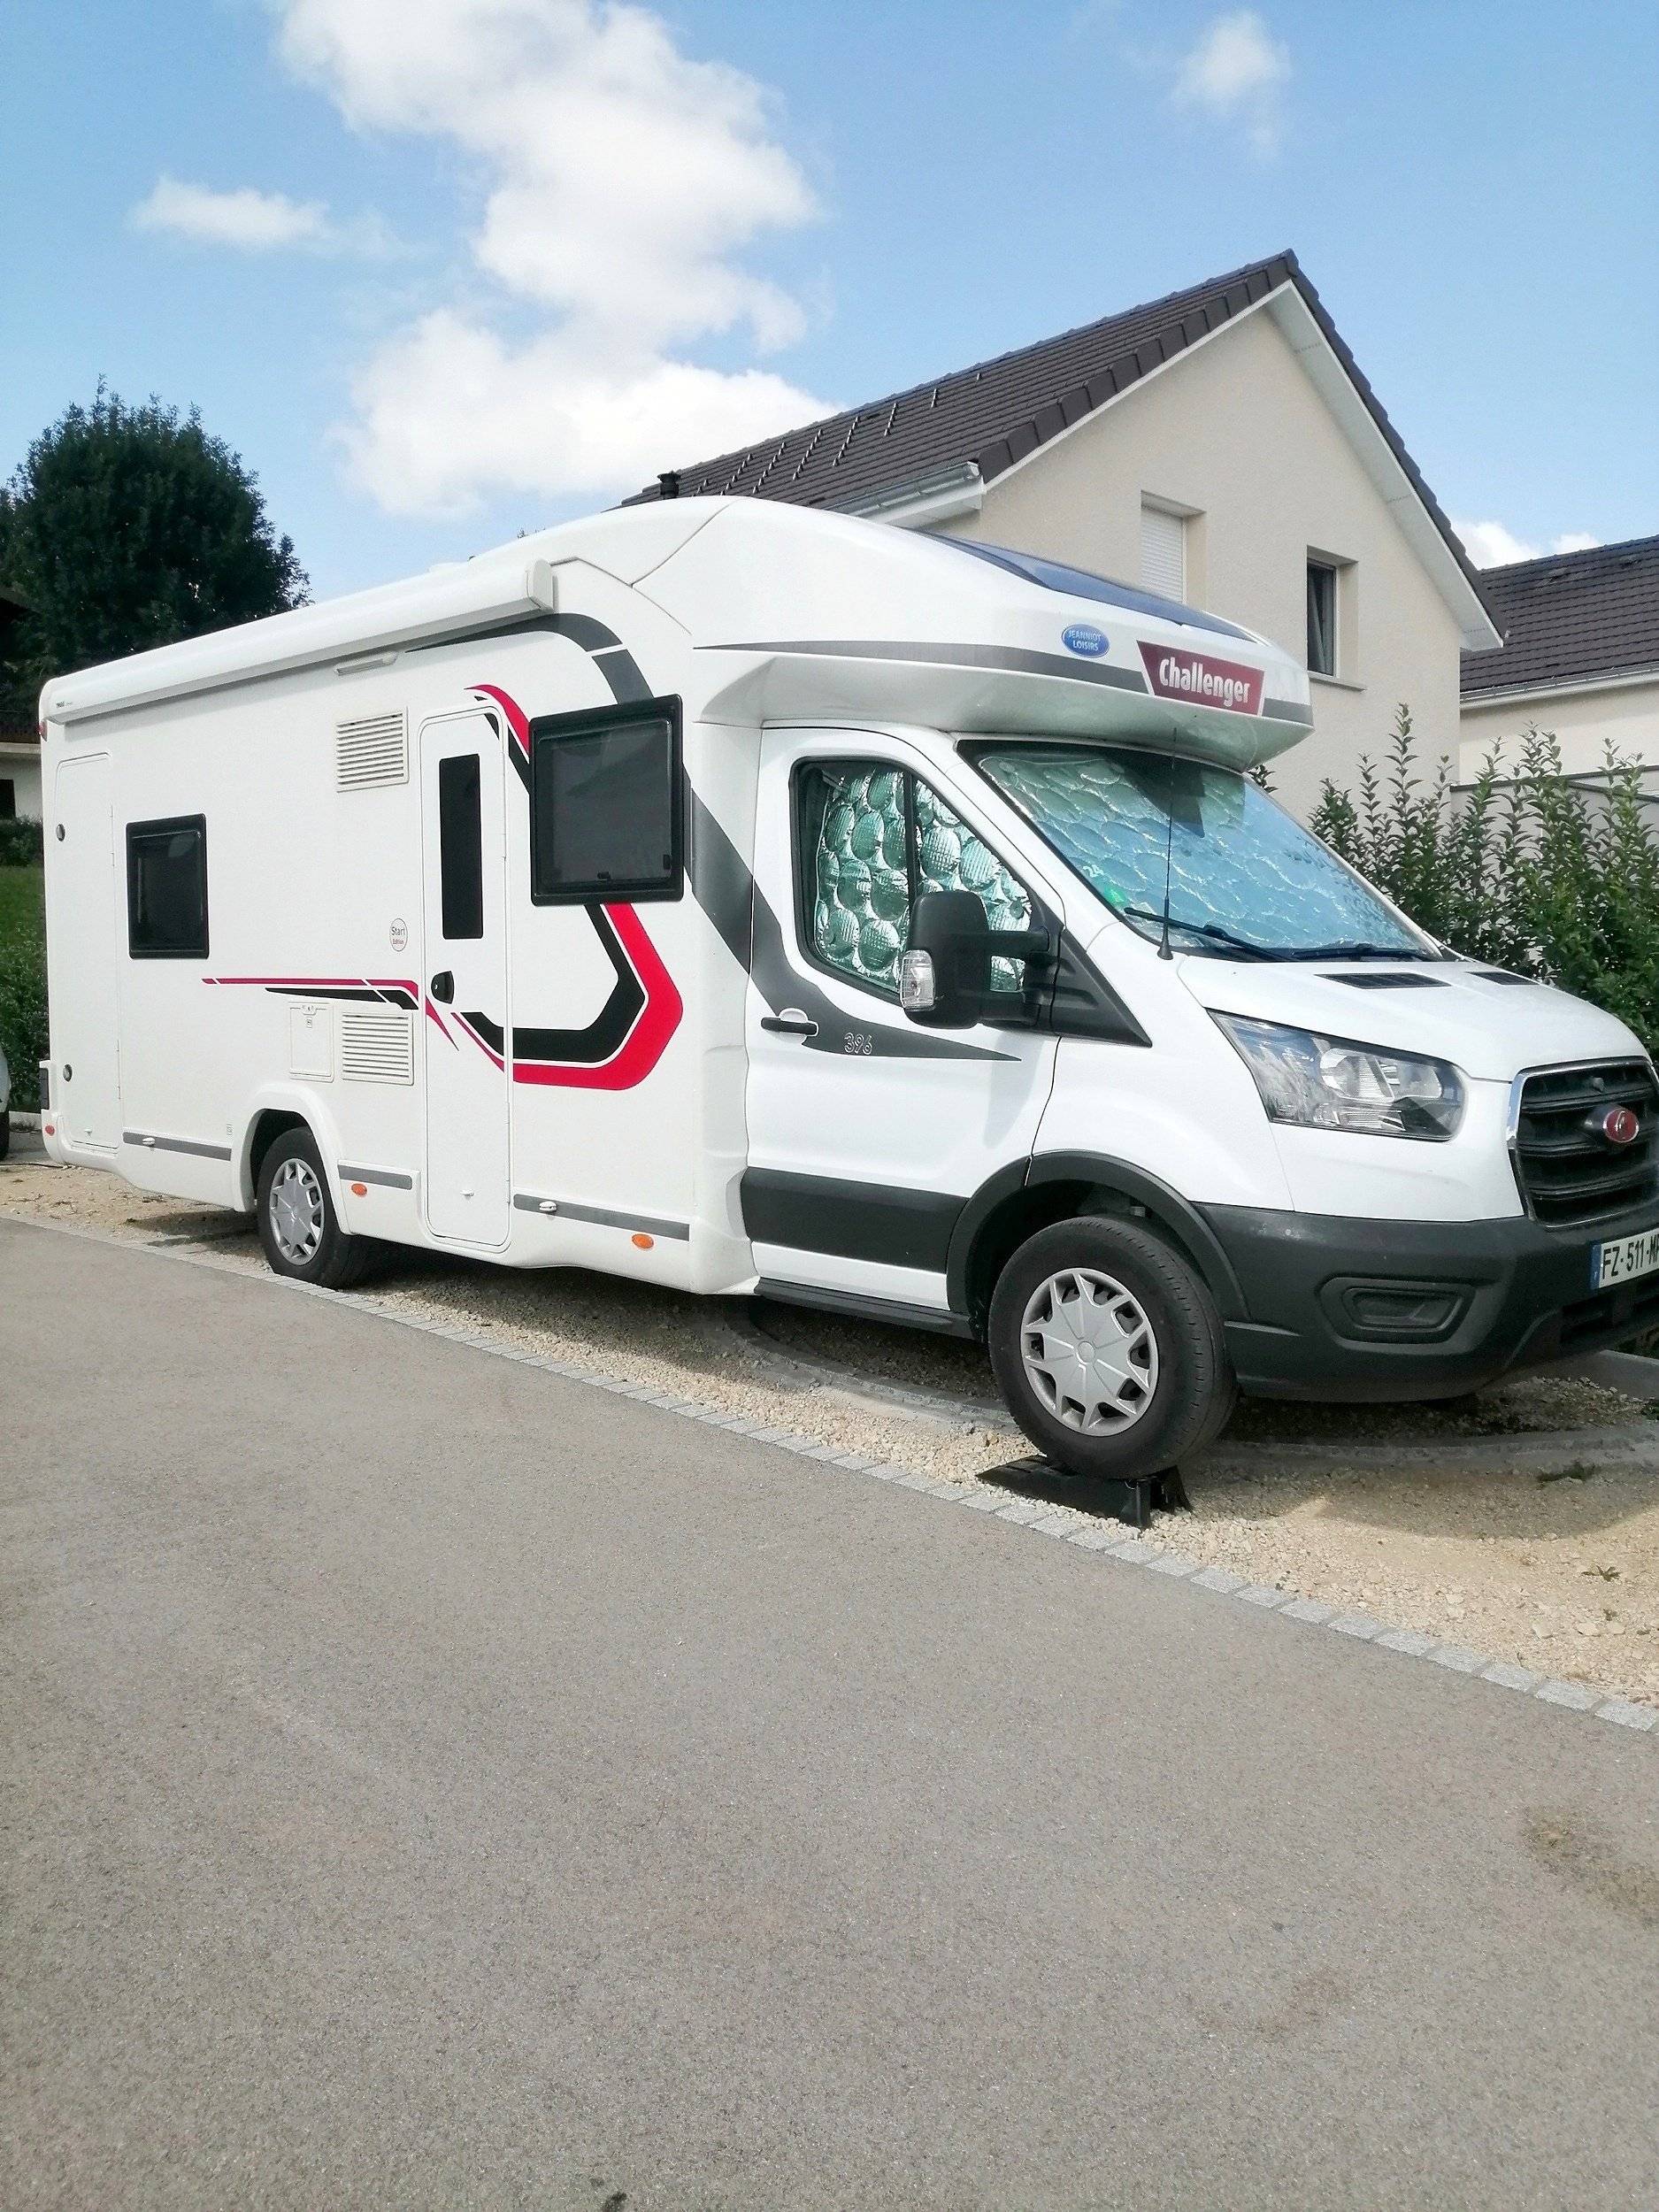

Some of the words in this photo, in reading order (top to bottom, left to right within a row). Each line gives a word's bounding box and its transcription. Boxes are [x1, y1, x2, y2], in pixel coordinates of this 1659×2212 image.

[1072, 640, 1099, 651] LOISIRS
[1159, 657, 1250, 707] Challenger
[391, 926, 405, 936] Start
[844, 1032, 872, 1056] 396
